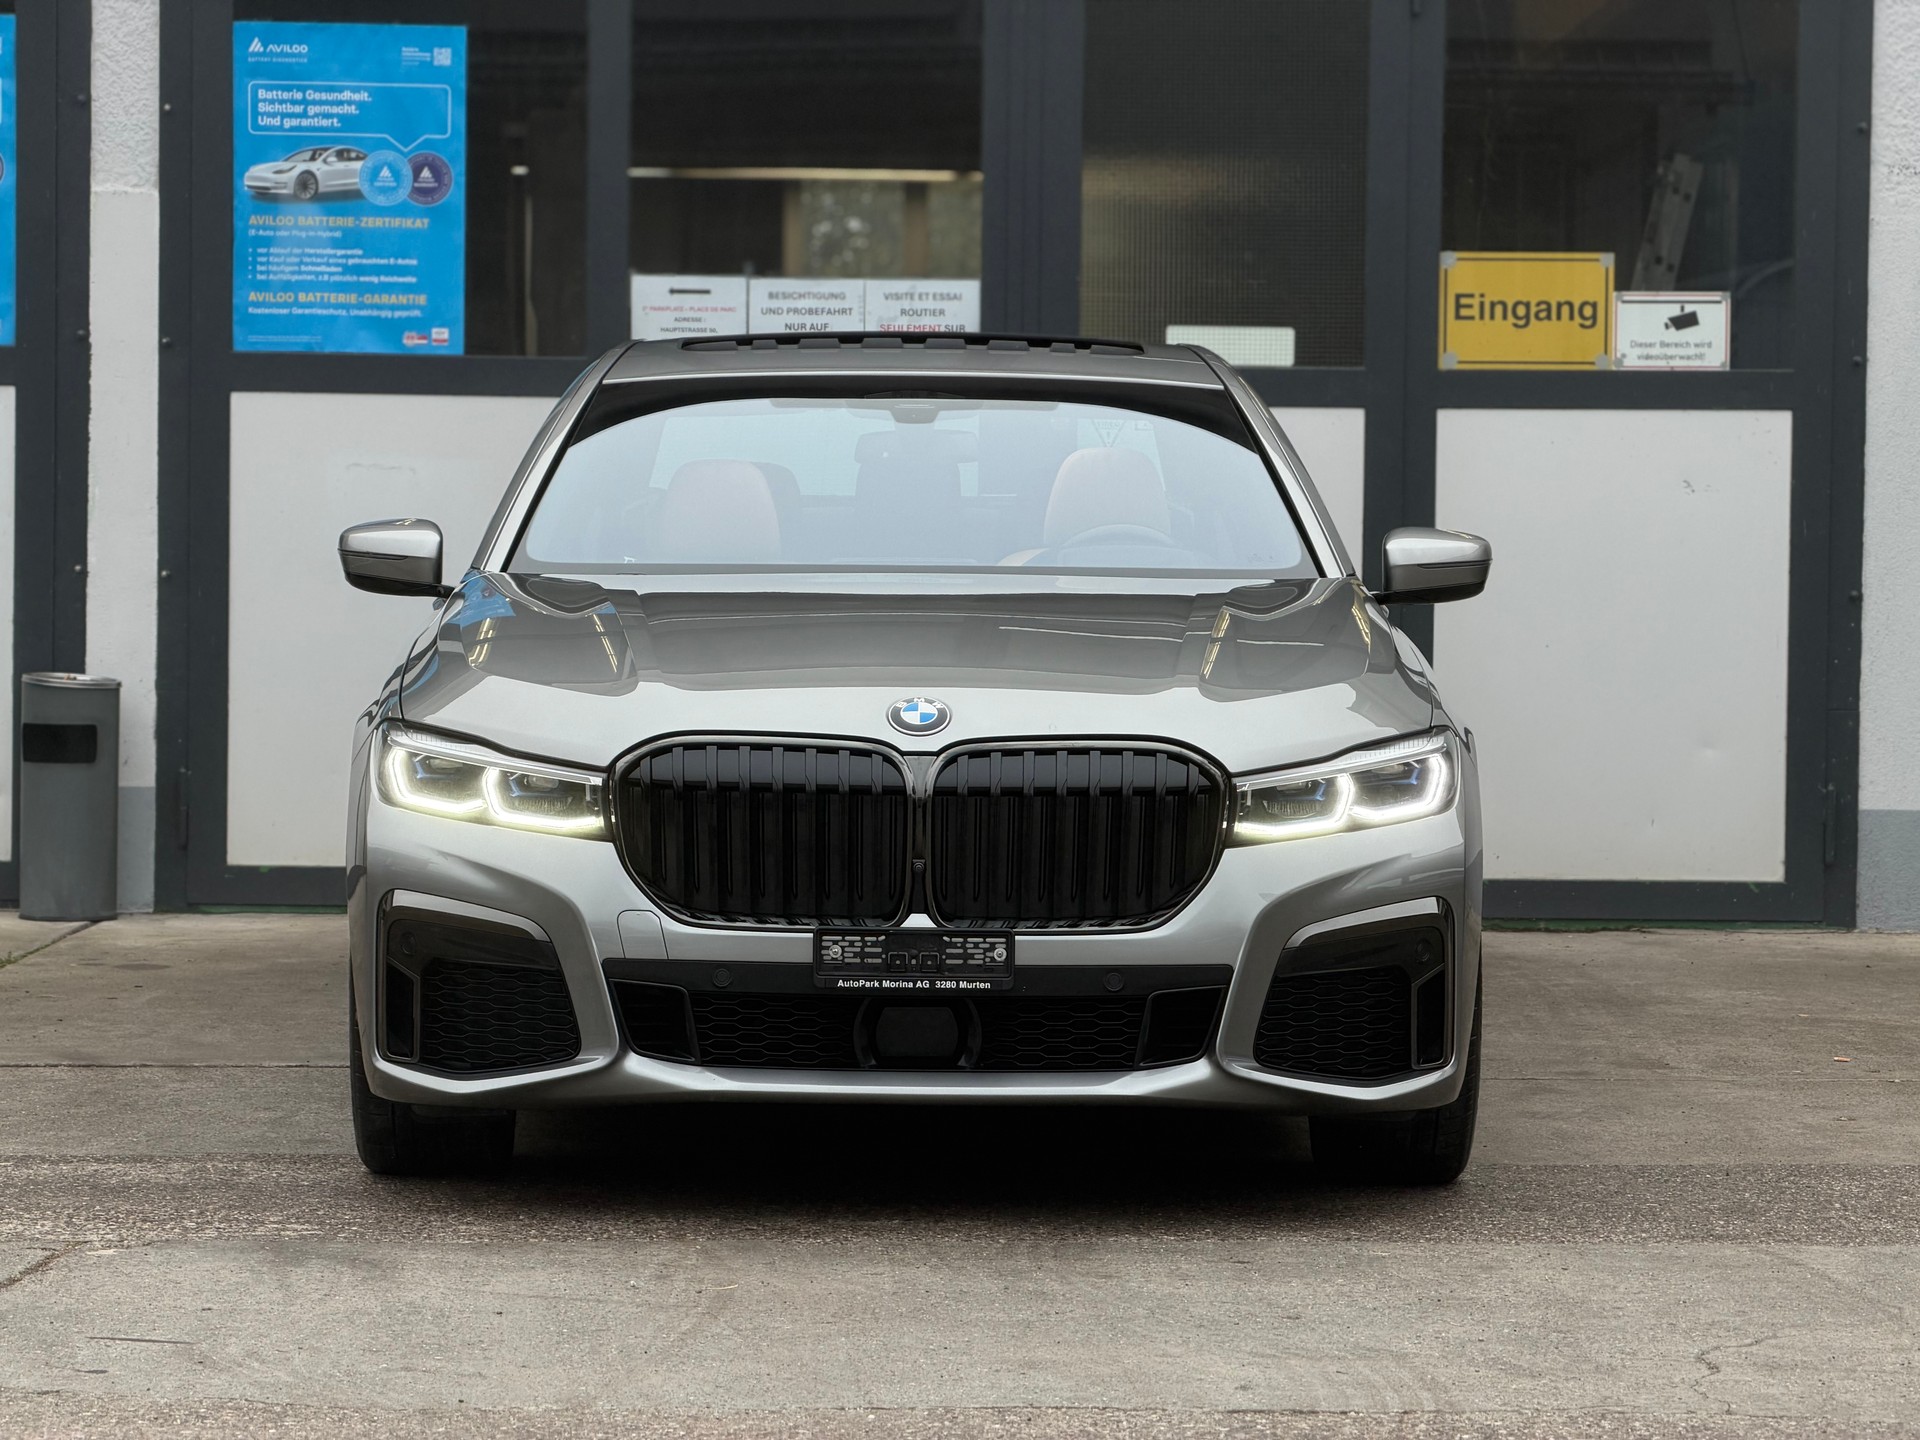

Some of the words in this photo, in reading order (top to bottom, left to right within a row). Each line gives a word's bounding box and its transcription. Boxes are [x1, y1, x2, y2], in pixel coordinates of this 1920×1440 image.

[266, 43, 308, 53] AVILOO
[258, 89, 303, 100] Batterie
[306, 90, 372, 101] Gesundheit.
[258, 102, 304, 113] Sichtbar
[307, 104, 359, 116] gemacht.
[258, 116, 281, 126] Und
[283, 117, 341, 128] garantiert.
[249, 215, 294, 226] AVILOO
[298, 216, 430, 229] BATTERIE-ZERTIFIKAT
[249, 292, 294, 303] AVILOO
[298, 292, 427, 305] BATTERIE-GARANTIE
[768, 291, 846, 301] BESICHTIGUNG
[883, 292, 915, 301] VISITE
[918, 292, 930, 301] ET
[932, 292, 962, 302] ESSAI
[248, 307, 290, 315] Kostenloser
[761, 306, 784, 316] UND
[786, 307, 853, 316] PROBEFAHRT
[900, 308, 946, 317] ROUTIER
[1454, 293, 1598, 329] Eingang
[785, 323, 807, 331] NUR
[809, 323, 830, 331] AUF
[879, 324, 942, 332] SEULEMENT
[944, 324, 966, 333] SUR
[1630, 340, 1657, 349] Dieser
[1659, 340, 1692, 349] Bereich
[1693, 340, 1712, 349] wird
[895, 697, 944, 708] BMW
[837, 979, 880, 988] AutoPark
[882, 980, 914, 988] Morina
[916, 980, 930, 988] AG
[959, 981, 991, 989] Murten
